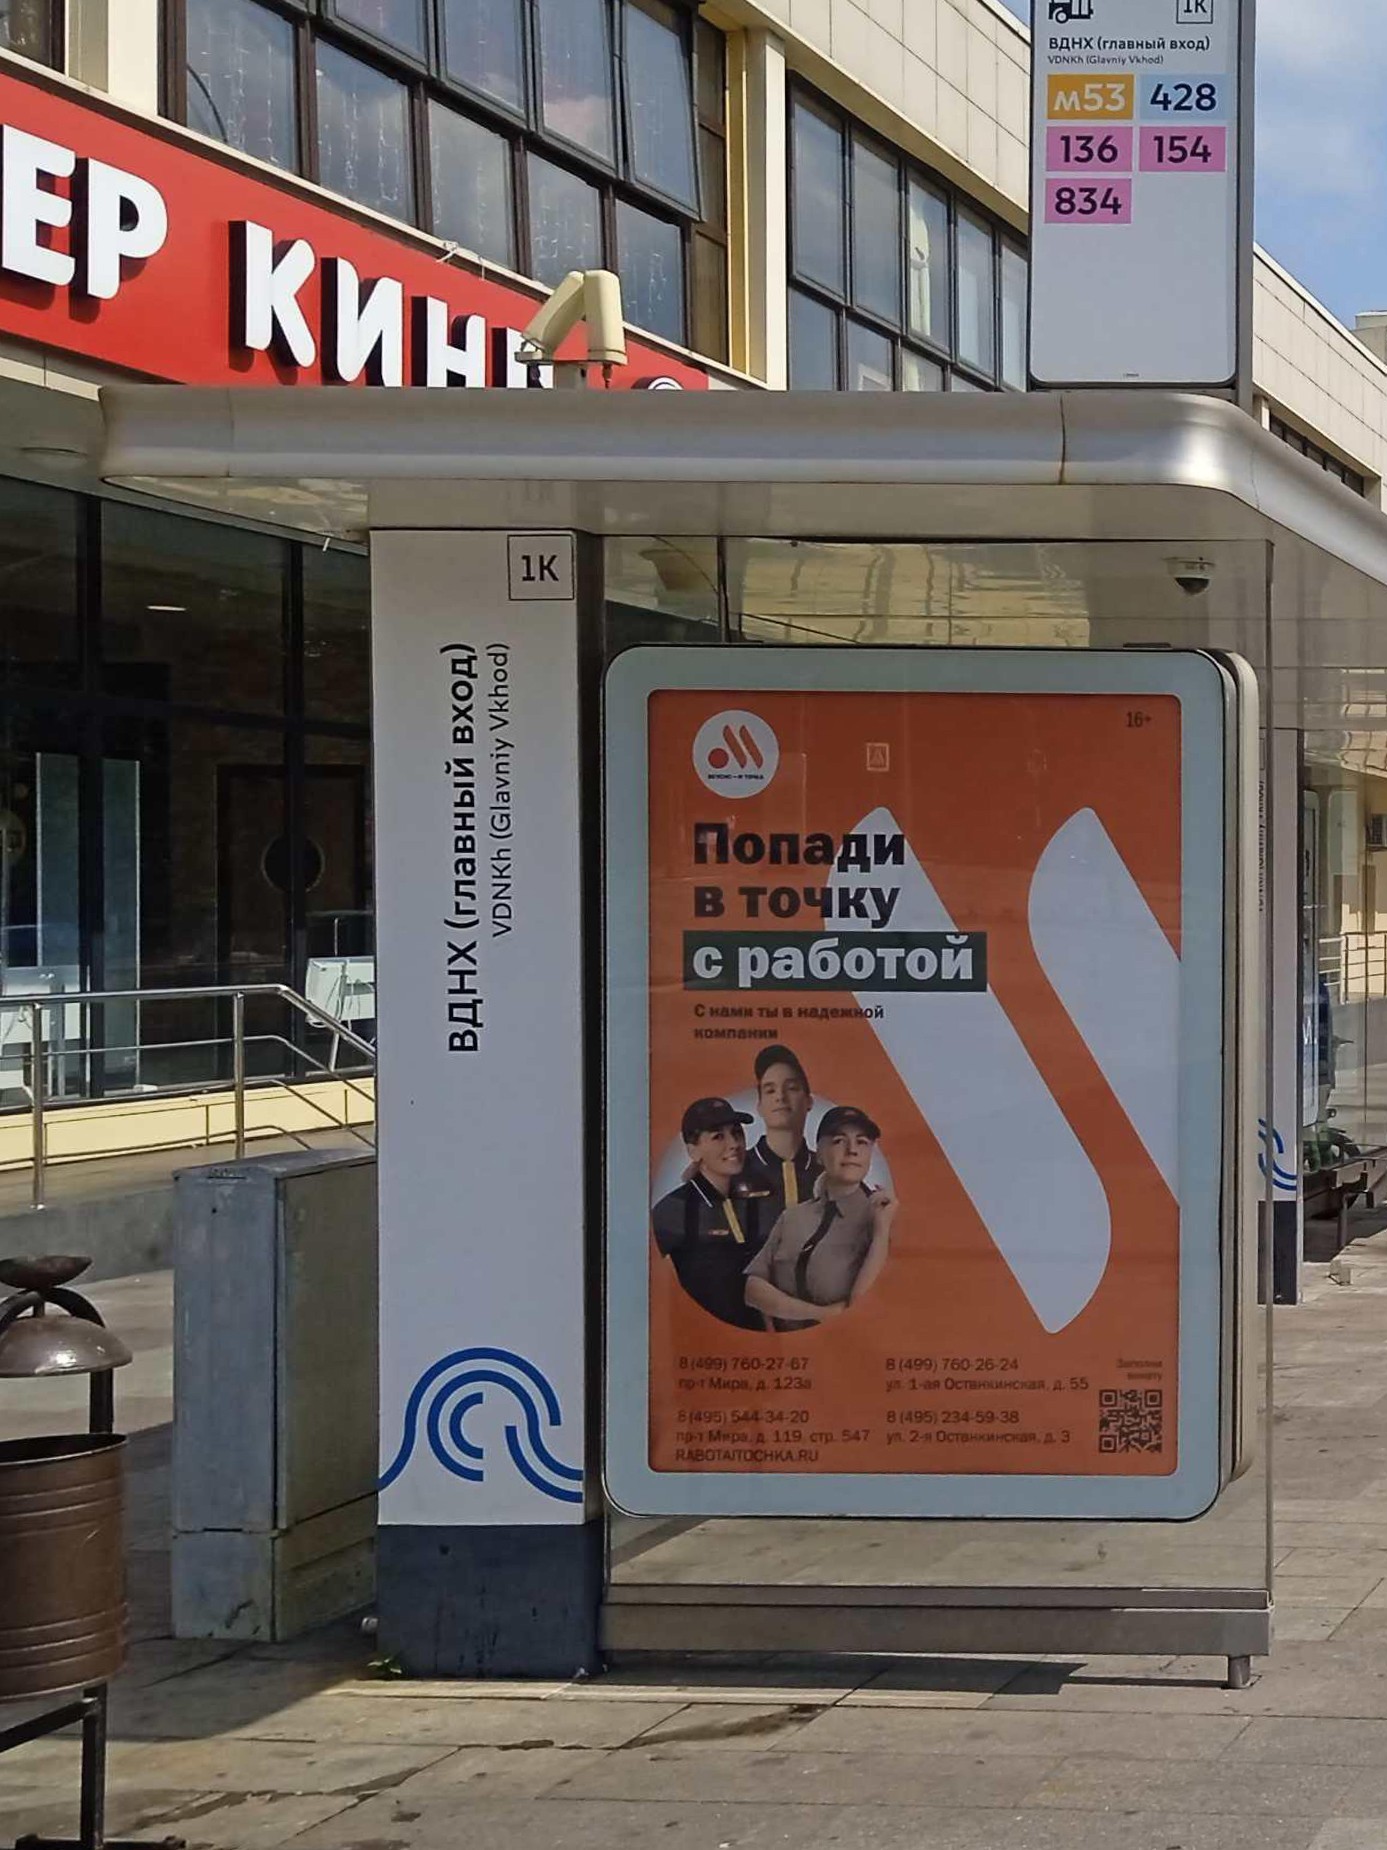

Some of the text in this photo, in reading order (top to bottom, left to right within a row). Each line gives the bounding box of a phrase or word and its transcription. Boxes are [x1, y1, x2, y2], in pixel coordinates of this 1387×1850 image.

[1048, 35, 1210, 51] ВДНХ (главный вход)
[1048, 54, 1165, 66] VDNKh (Glavniy Vkhod)
[1053, 83, 1217, 113] м53 428
[1060, 135, 1212, 164] 136 154
[1054, 187, 1122, 215] 834
[1126, 711, 1152, 728] 16+
[486, 643, 514, 937] VDNKh (Glavniy Vkhod)
[440, 643, 483, 1053] ВДНХ (главный вход)
[694, 823, 905, 873] Попади
[694, 886, 901, 930] в точку
[693, 934, 974, 987] с работой
[694, 1004, 884, 1020] С нами ты в надежной
[694, 1027, 779, 1040] компании
[885, 1358, 1019, 1374] 8 (499) 760-26-24
[1070, 1377, 1090, 1390] 55
[886, 1410, 1020, 1426] 8 (495) 234-59-38
[841, 1430, 870, 1442] 547
[909, 1430, 933, 1443] 2-я
[1061, 1430, 1071, 1443] 3
